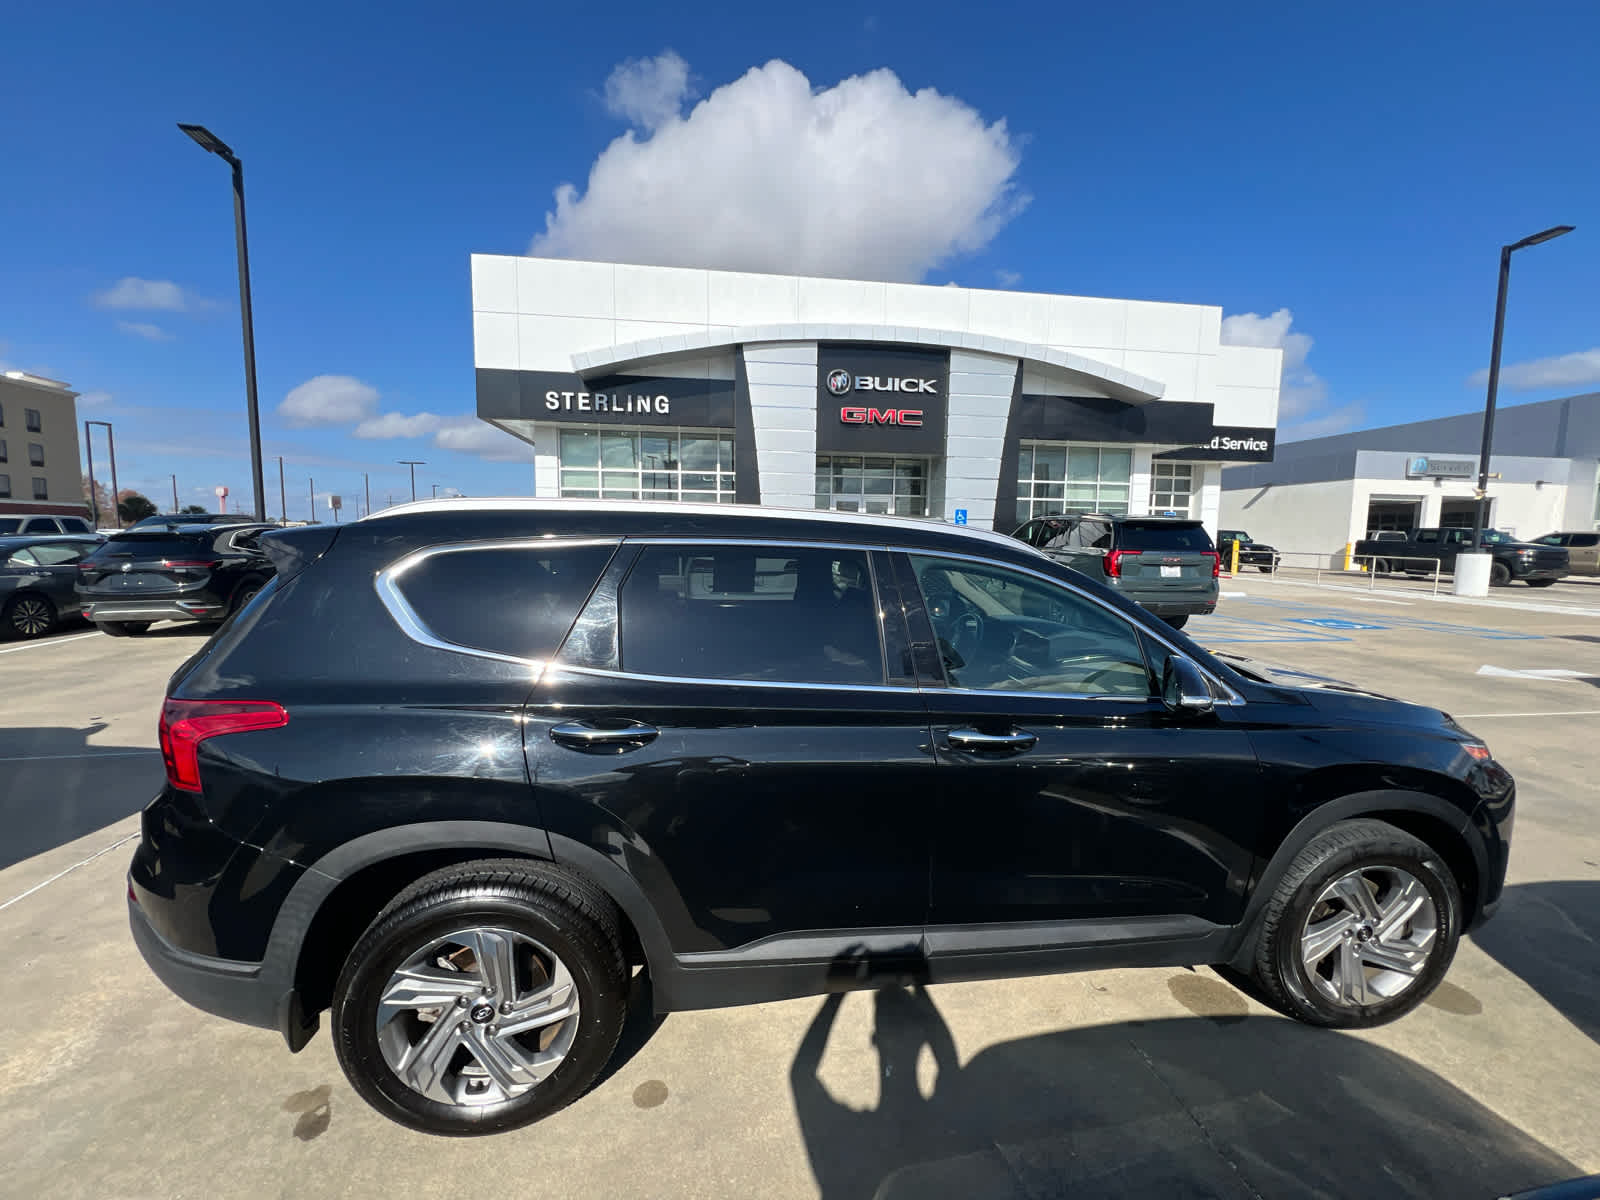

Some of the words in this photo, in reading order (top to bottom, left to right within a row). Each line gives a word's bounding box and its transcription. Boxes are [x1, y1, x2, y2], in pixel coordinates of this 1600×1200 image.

[854, 376, 937, 394] BUICK
[545, 391, 670, 414] STERLING
[841, 407, 923, 426] GMC
[1222, 437, 1268, 451] Service
